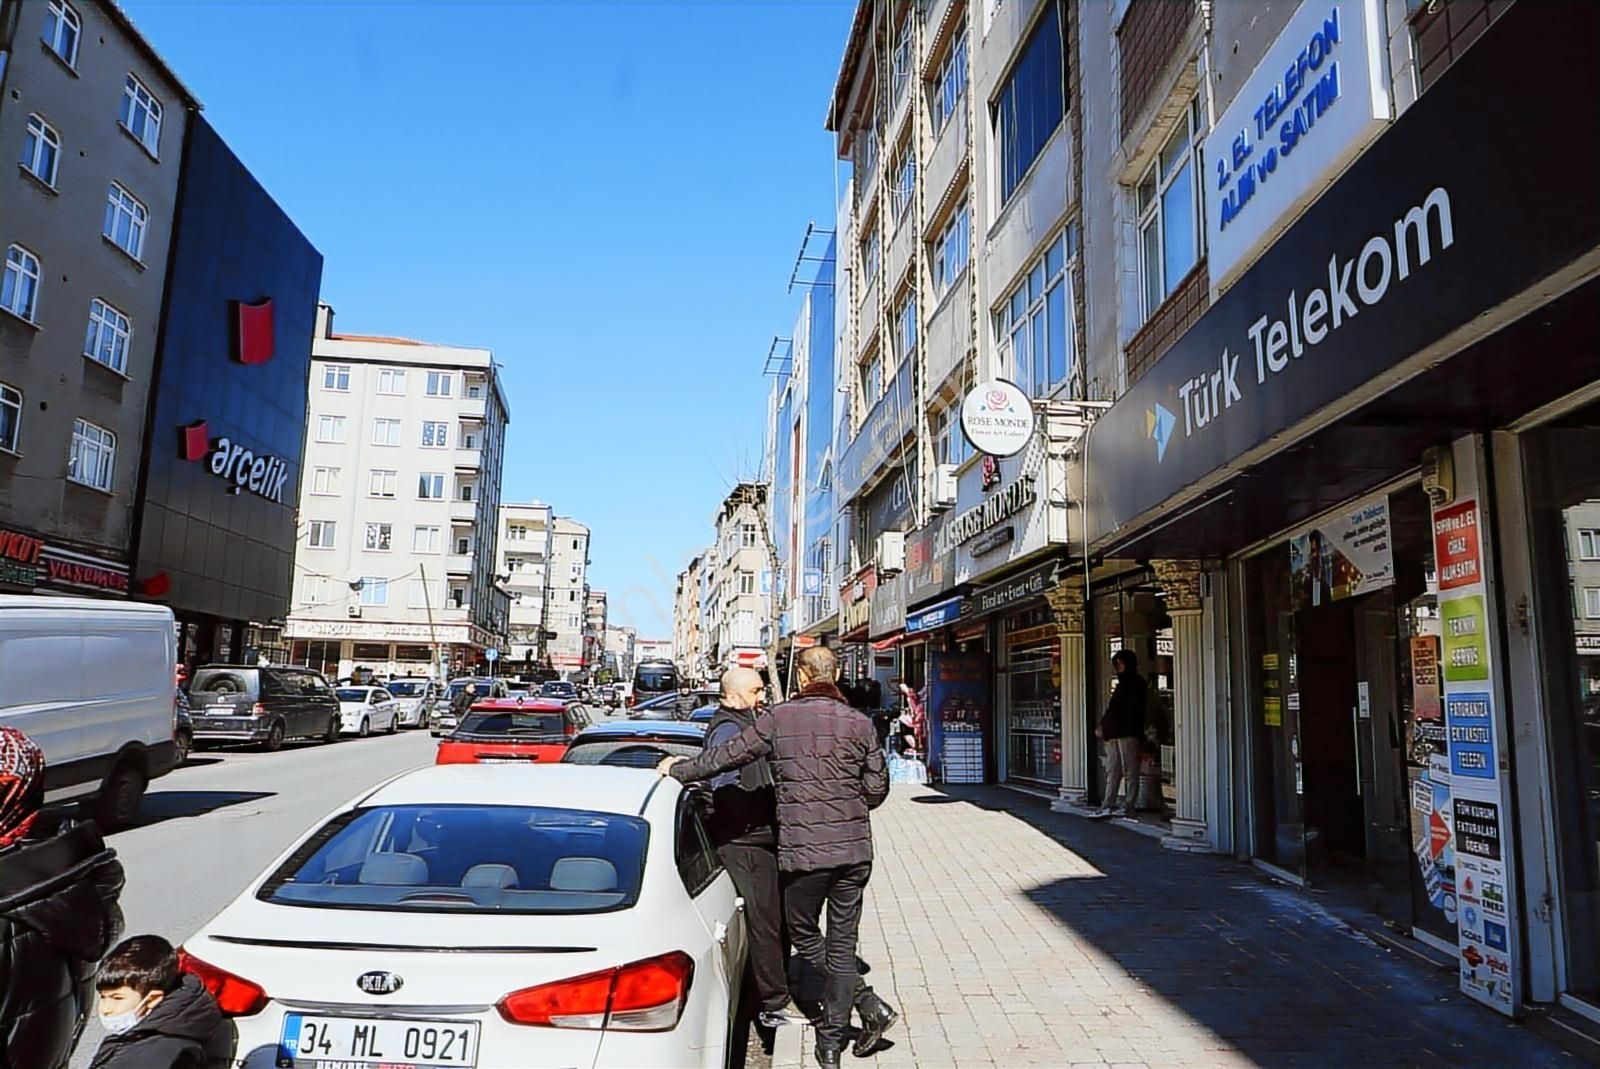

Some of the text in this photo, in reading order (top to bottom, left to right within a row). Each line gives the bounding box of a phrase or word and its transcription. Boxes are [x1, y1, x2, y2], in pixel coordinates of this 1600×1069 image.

[1231, 127, 1254, 169] EL
[1253, 5, 1343, 140] TELEFON
[1279, 61, 1344, 159] SATIM
[1177, 186, 1455, 437] Türk Telekom
[967, 415, 1029, 429] ROSE MONDE
[211, 436, 289, 504] arçelik
[982, 476, 1036, 531] MONDE
[361, 974, 396, 992] KIA
[285, 1023, 470, 1061] TR 34 ML 0921
